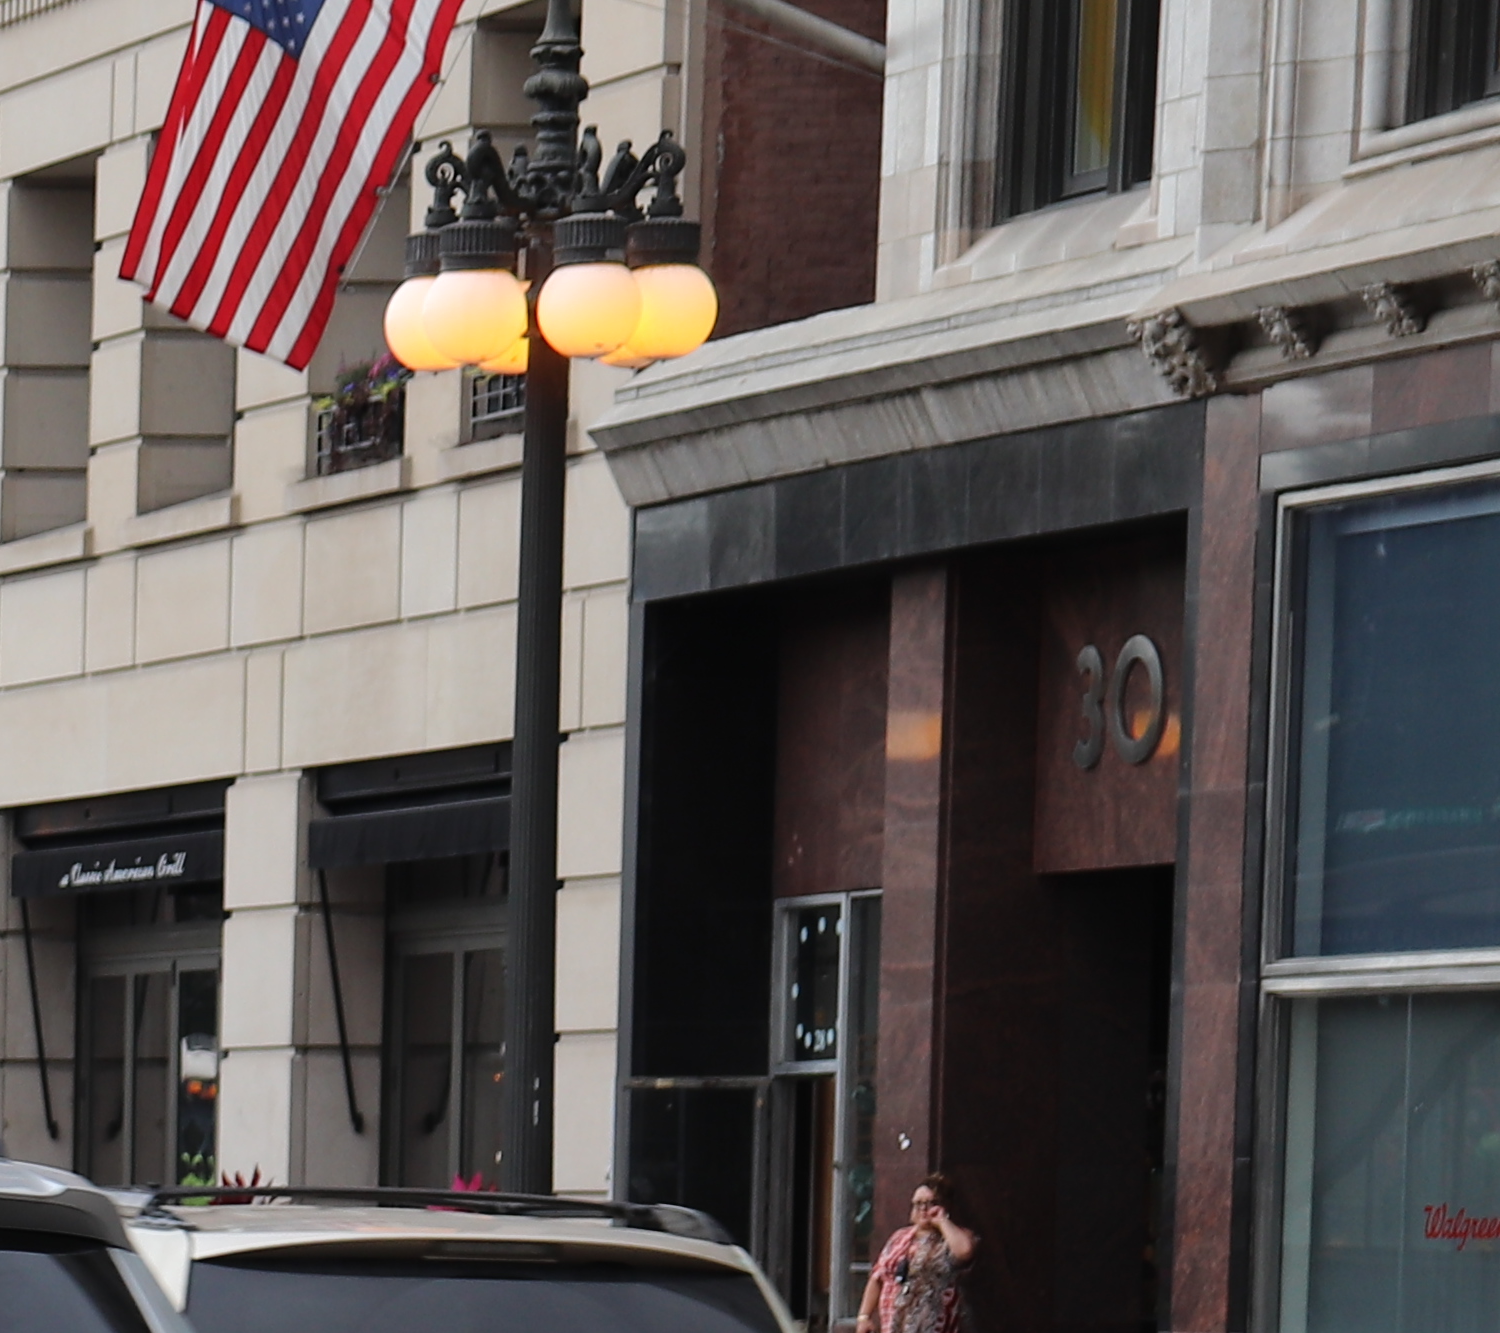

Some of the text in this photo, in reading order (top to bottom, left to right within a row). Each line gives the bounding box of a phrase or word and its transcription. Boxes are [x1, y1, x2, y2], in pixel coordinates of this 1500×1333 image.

[1073, 634, 1163, 769] 30
[156, 852, 186, 879] Grill
[1423, 1201, 1500, 1251] Walgree
